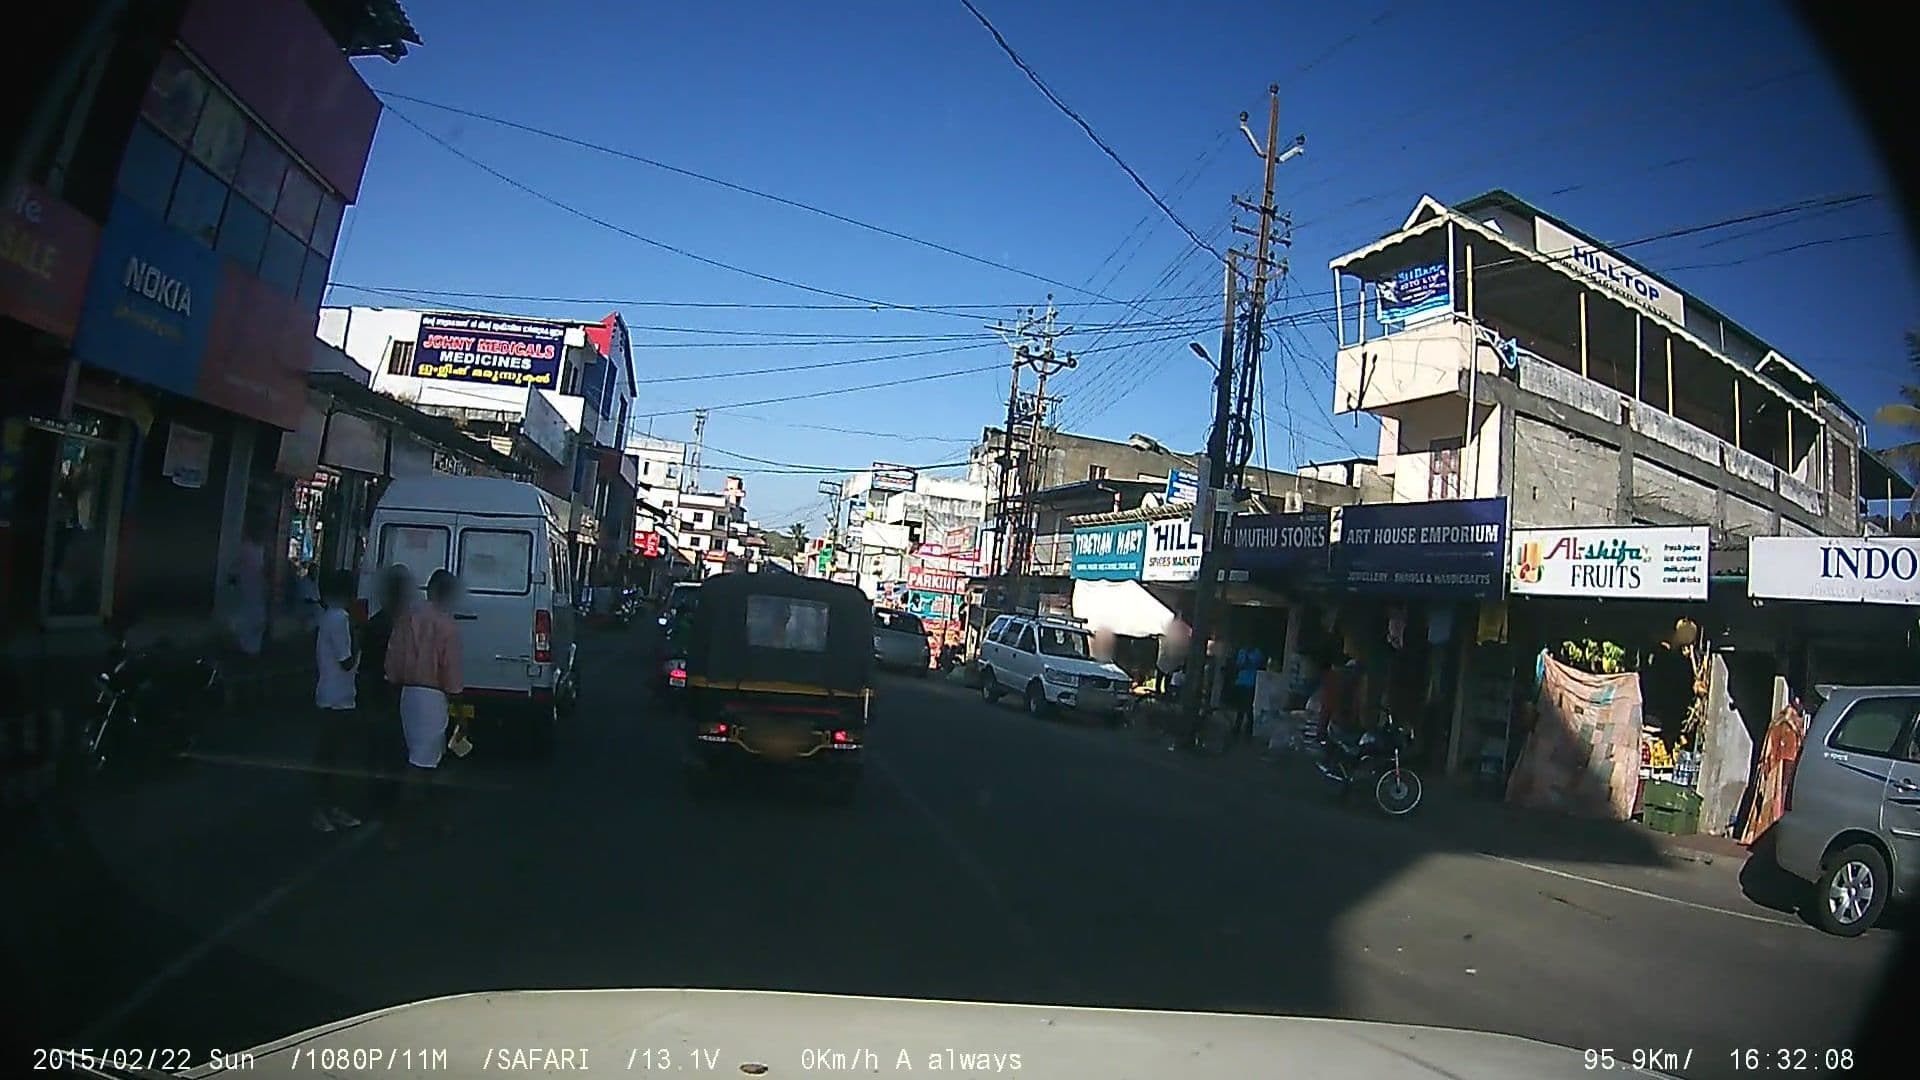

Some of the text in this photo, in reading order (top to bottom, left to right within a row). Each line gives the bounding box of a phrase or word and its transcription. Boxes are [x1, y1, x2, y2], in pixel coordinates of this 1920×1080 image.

[1573, 245, 1661, 300] HILLTOP
[124, 257, 192, 318] NOKIA
[423, 334, 555, 359] JOHNY MEDICALS
[440, 351, 532, 370] MEDICINES
[1154, 523, 1198, 551] HILL
[1280, 526, 1325, 547] STORES
[1347, 524, 1499, 544] ART HOUSE EMPORIUM
[1820, 546, 1918, 580] INDO
[1571, 565, 1641, 588] FRUITS
